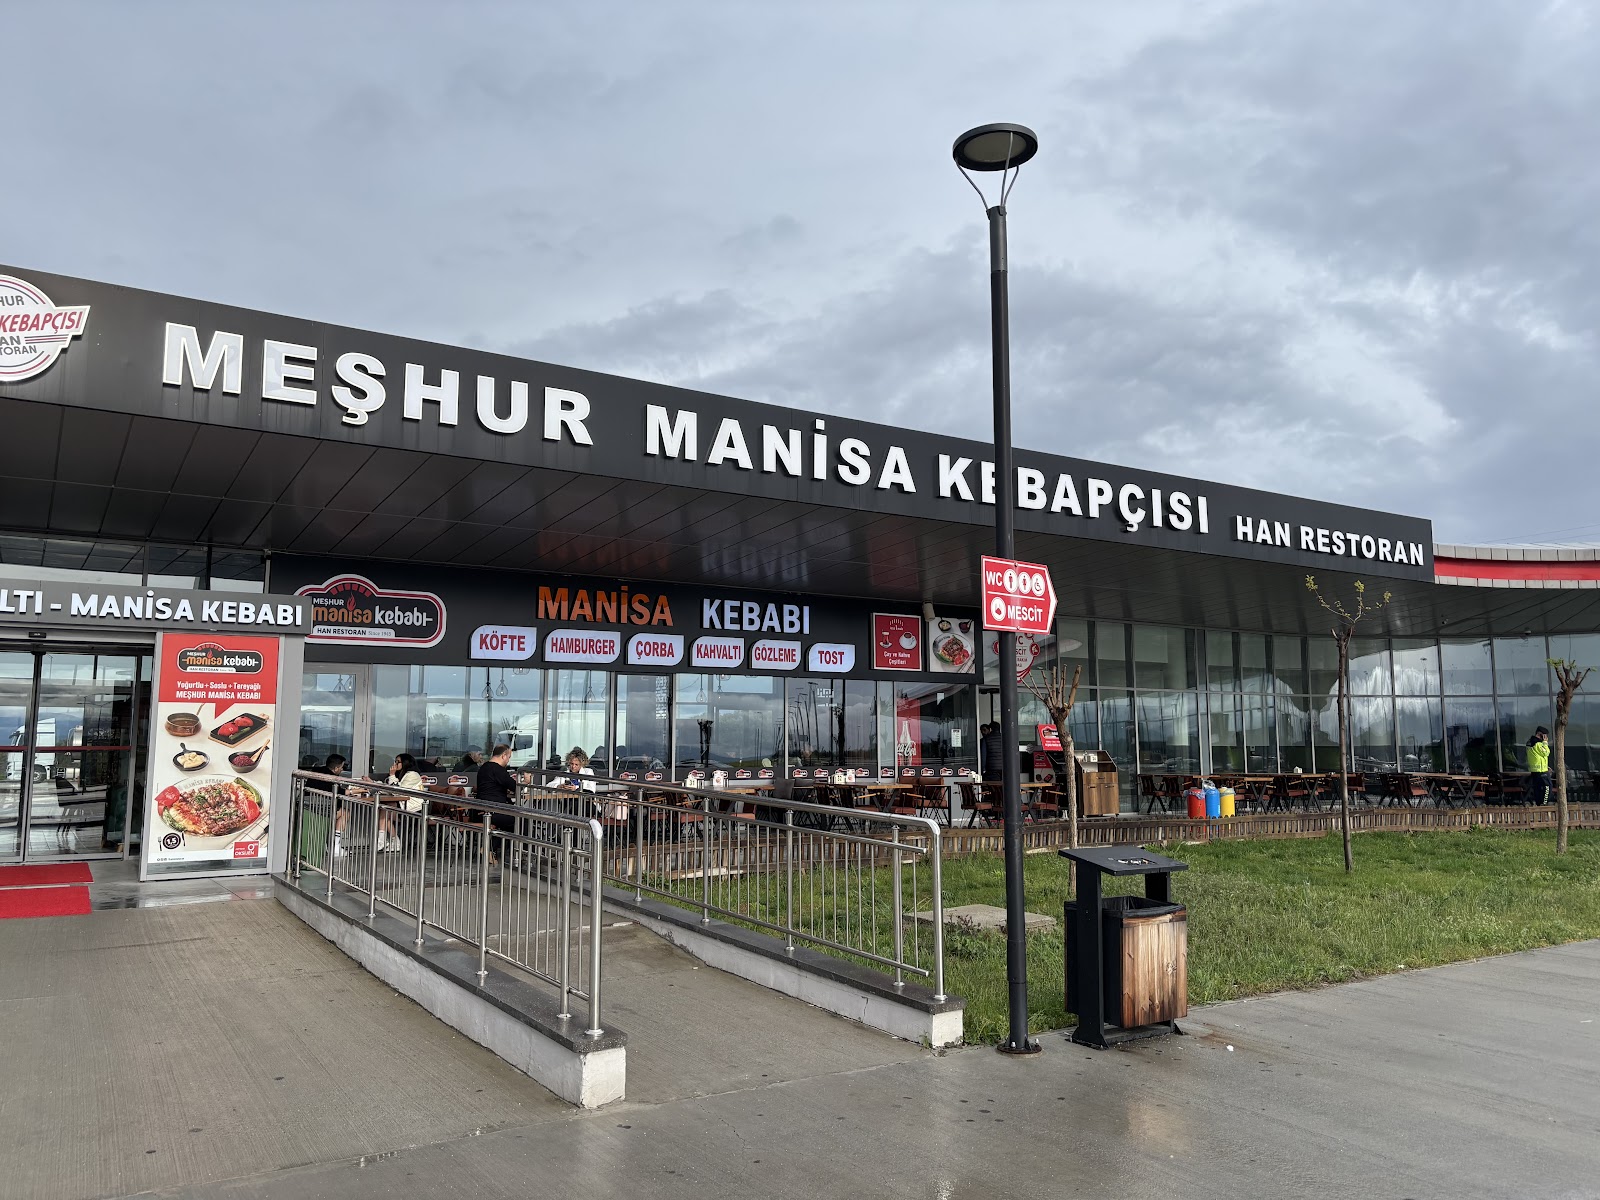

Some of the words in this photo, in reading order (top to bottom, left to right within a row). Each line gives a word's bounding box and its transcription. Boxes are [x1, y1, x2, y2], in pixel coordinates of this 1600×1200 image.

[0, 311, 83, 334] KEBAPÇISI
[163, 322, 593, 445] MEŞHUR
[646, 404, 917, 493] MANİSA
[938, 454, 1209, 534] KEBAPÇISI
[1236, 515, 1291, 547] HAN
[1300, 525, 1424, 566] RESTORAN
[986, 570, 1003, 586] WC
[71, 590, 194, 621] MANİSA
[202, 600, 302, 626] KEBABI
[313, 597, 345, 606] MEŞHUR
[313, 607, 373, 623] manisa
[538, 586, 673, 626] MANİSA
[703, 598, 809, 635] KEBABI
[1007, 605, 1043, 623] MESCİT
[333, 628, 367, 636] RESTORAN
[479, 631, 526, 651] KÖFTE
[551, 637, 615, 655] HAMBURGER
[635, 640, 675, 659] ÇORBA
[187, 656, 222, 665] manisa
[696, 644, 741, 660] KAHVALTI
[754, 643, 797, 663] GÖZLEME
[818, 650, 844, 665] TOST
[177, 681, 204, 690] Yoğurtlu
[209, 681, 227, 689] Soslu
[176, 690, 206, 700] MEŞHUR
[208, 690, 235, 699] MANİSA
[237, 692, 261, 700] KEBABI
